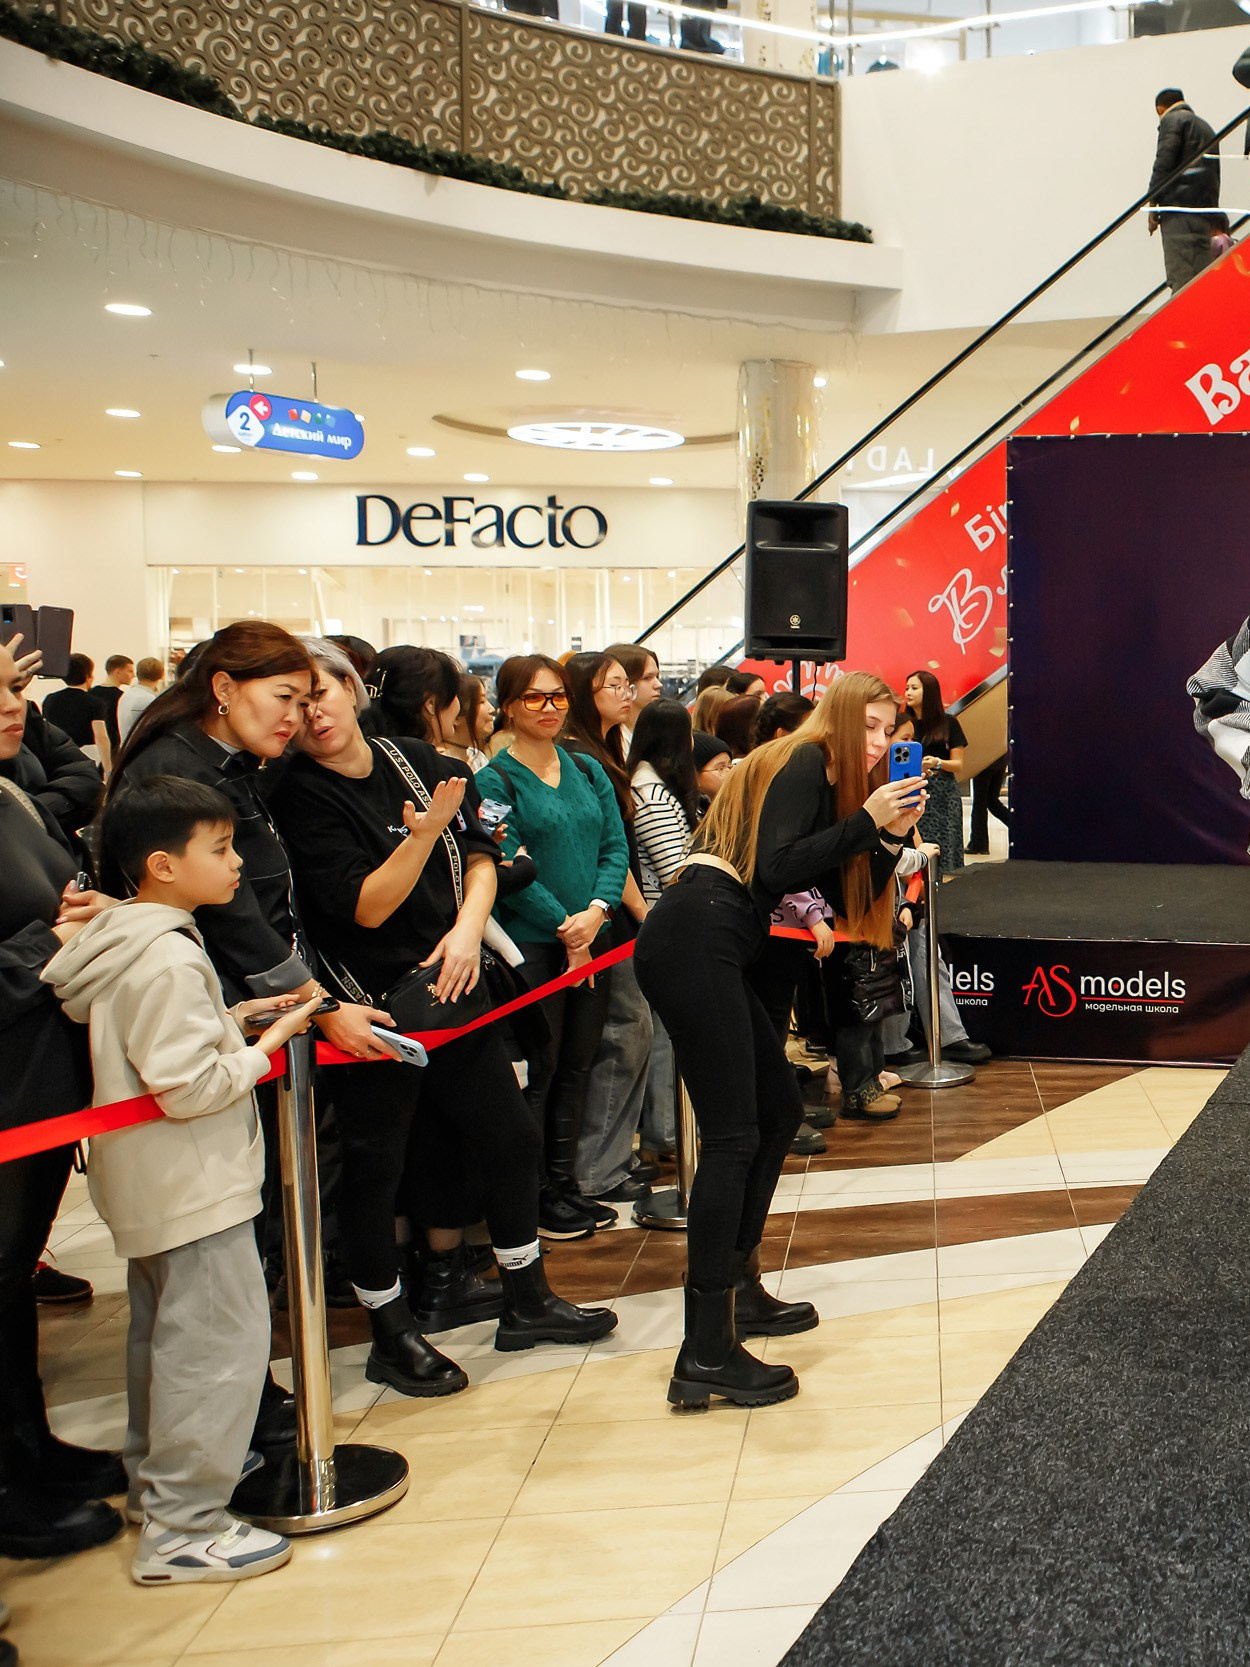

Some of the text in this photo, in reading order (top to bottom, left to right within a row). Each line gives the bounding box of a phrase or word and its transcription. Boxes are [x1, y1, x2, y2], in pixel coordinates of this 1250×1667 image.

[239, 411, 251, 431] 2
[272, 423, 325, 443] Детский
[326, 434, 352, 450] мир
[356, 494, 608, 549] DeFacto
[402, 766, 421, 789] POLO
[1080, 970, 1187, 999] models
[956, 998, 988, 1006] школа
[1085, 1002, 1179, 1014] модельная школа
